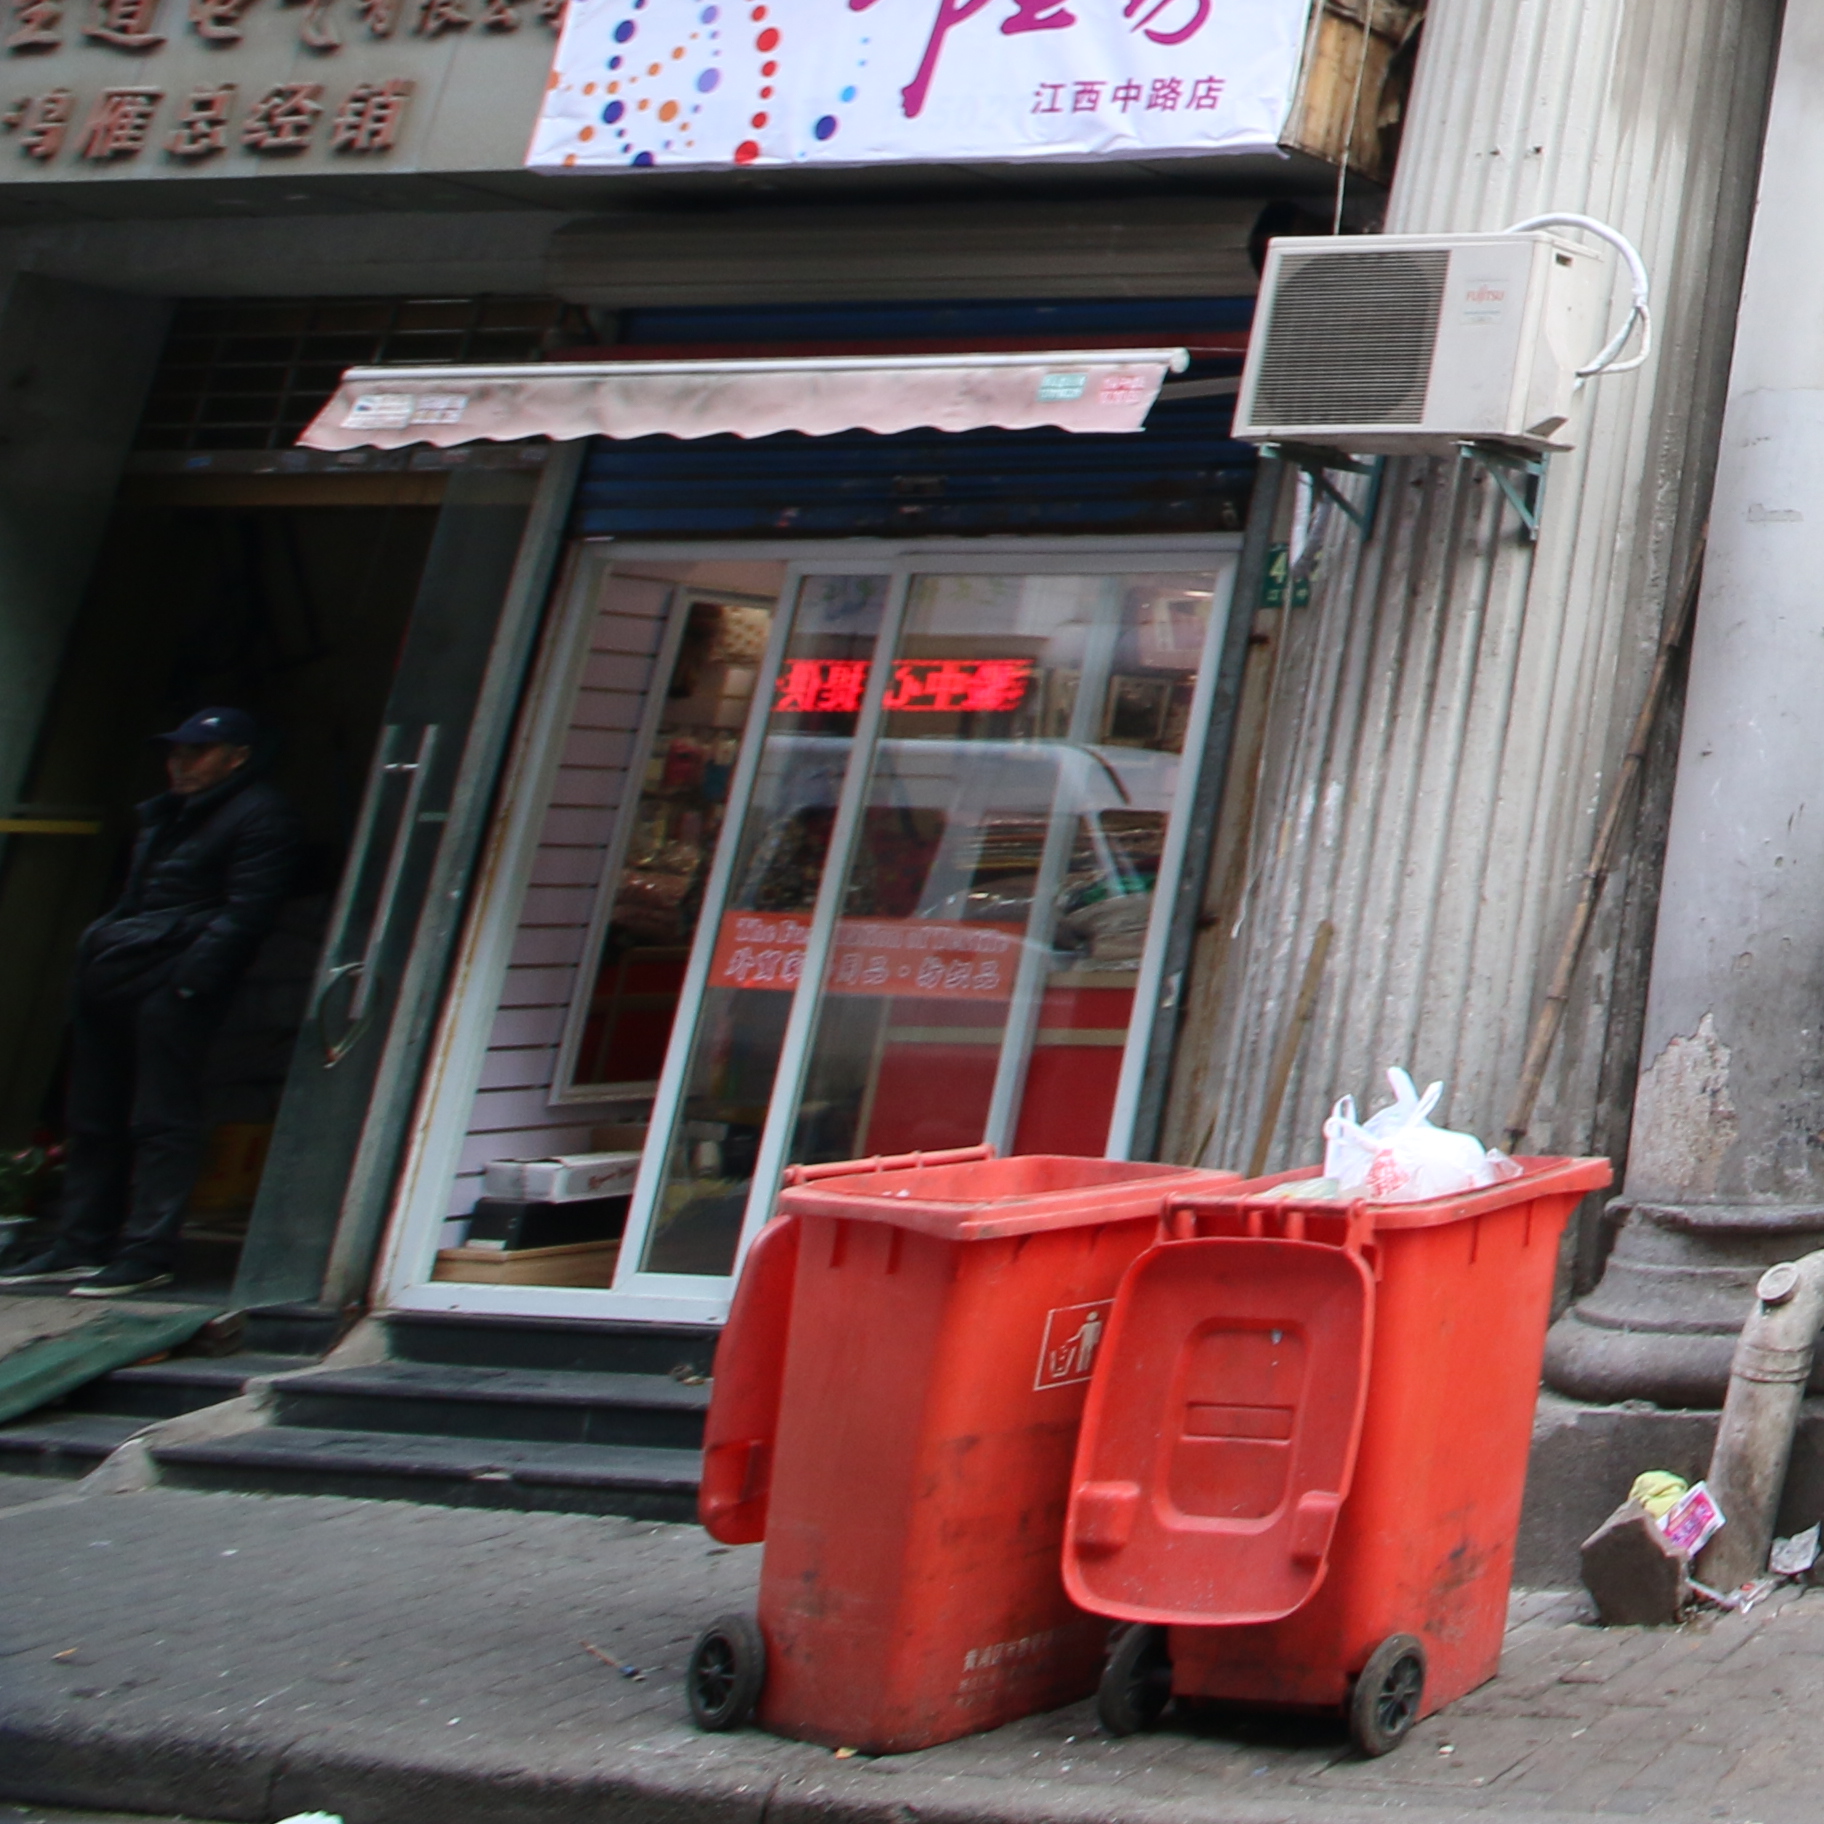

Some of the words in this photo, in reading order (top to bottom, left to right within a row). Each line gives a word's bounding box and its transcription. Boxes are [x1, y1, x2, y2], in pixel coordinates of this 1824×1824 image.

[1030, 76, 1226, 116] 江西中路店
